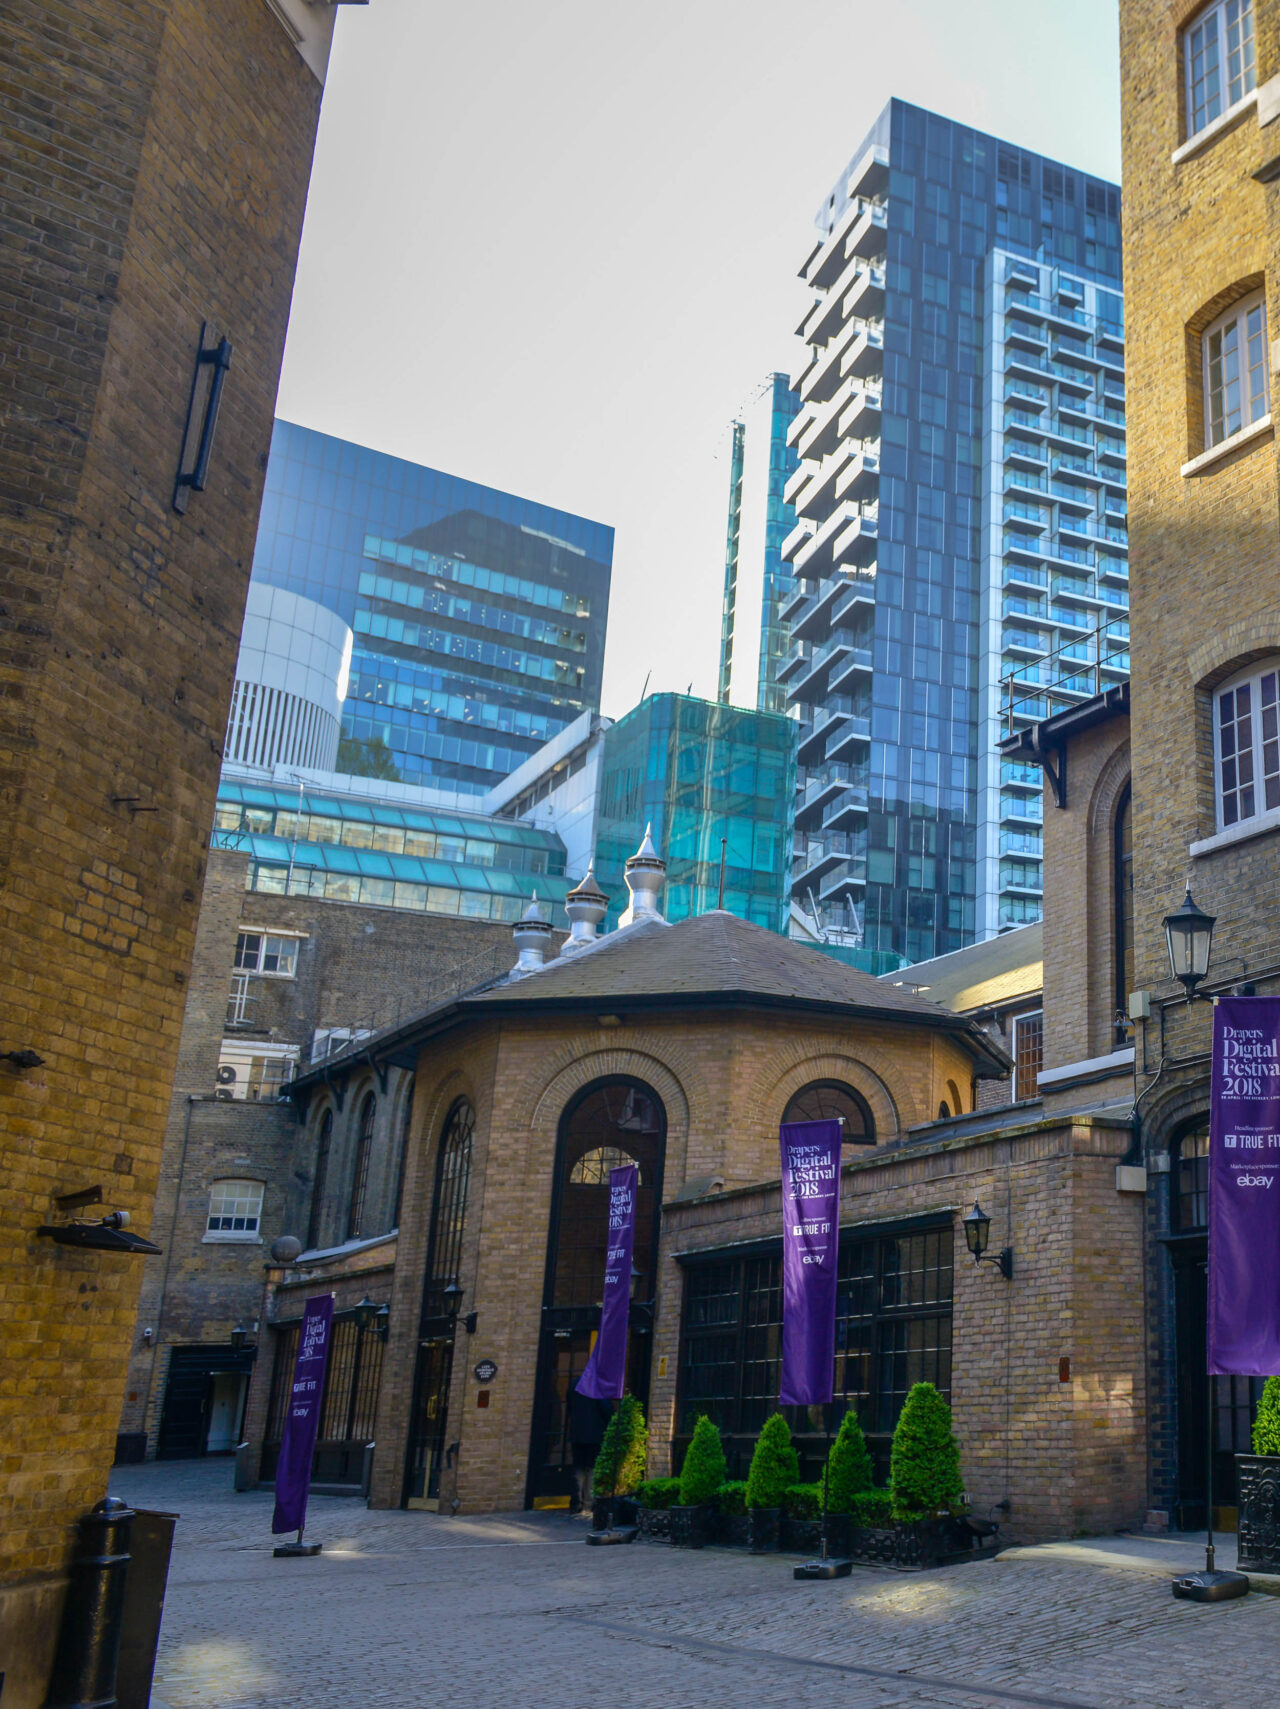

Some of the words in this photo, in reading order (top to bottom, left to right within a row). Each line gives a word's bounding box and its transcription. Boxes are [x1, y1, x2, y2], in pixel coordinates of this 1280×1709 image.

[1223, 1026, 1264, 1042] Drapers
[1223, 1038, 1279, 1063] Digital
[1221, 1077, 1262, 1096] 2018
[1239, 1135, 1264, 1149] TRUE
[788, 1151, 831, 1171] Digital
[789, 1164, 836, 1182] Festival
[1236, 1173, 1274, 1189] ebay
[789, 1181, 819, 1197] 2018
[610, 1201, 632, 1216] estival
